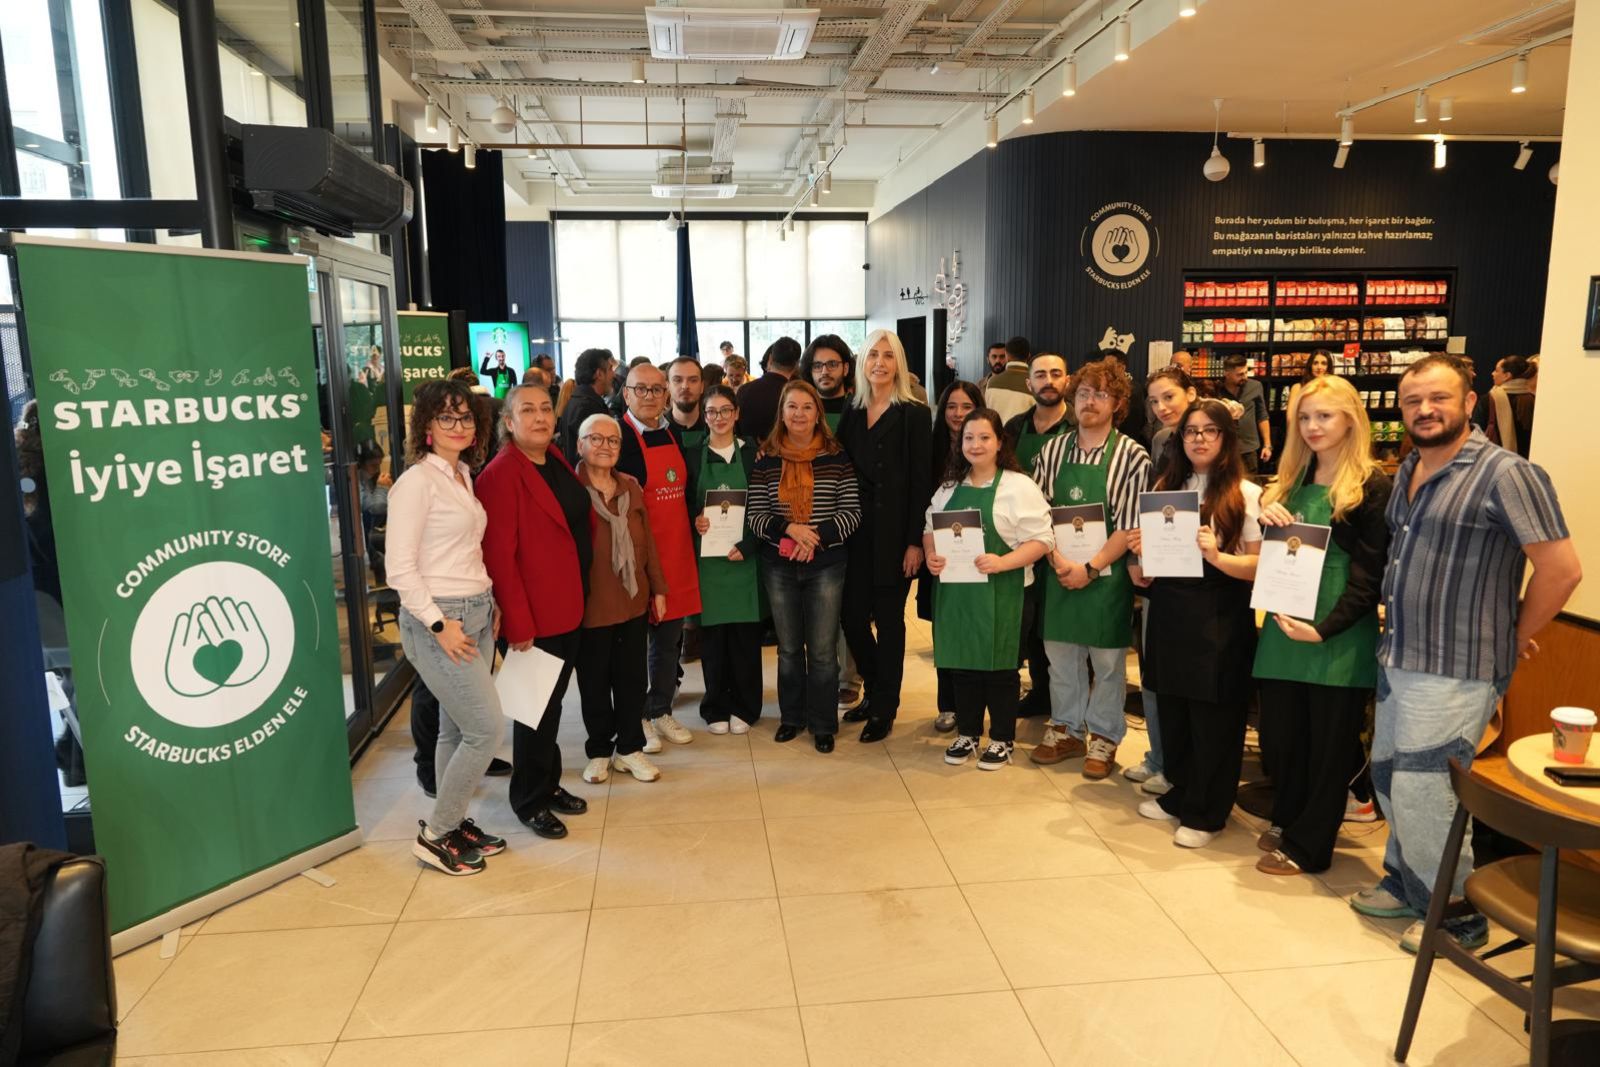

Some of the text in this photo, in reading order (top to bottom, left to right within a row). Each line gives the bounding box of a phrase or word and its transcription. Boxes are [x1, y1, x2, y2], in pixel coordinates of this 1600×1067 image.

[1090, 202, 1152, 222] COMMUNITY STORE
[1215, 216, 1246, 225] Burada
[1247, 216, 1261, 224] her
[1262, 217, 1292, 227] yudum
[1308, 216, 1348, 226] buluşma,
[1349, 217, 1363, 225] her
[1365, 217, 1390, 226] işaret
[1405, 217, 1436, 226] bağdır.
[1213, 232, 1225, 240] Bu
[1226, 232, 1273, 241] mağazanın
[1275, 231, 1320, 240] baristaları
[1322, 231, 1356, 241] yalnızca
[1358, 231, 1383, 239] kahve
[1212, 247, 1252, 256] empatiyi
[1265, 246, 1298, 256] anlayışı
[1300, 246, 1332, 254] birlikte
[1332, 246, 1366, 254] demler.
[1085, 266, 1152, 290] STARBUCKS ELDEN ELE
[69, 440, 309, 502] İyiye İşaret
[116, 530, 291, 598] COMMUNITY STORE
[124, 686, 308, 764] STARBUCKS ELDEN ELE
